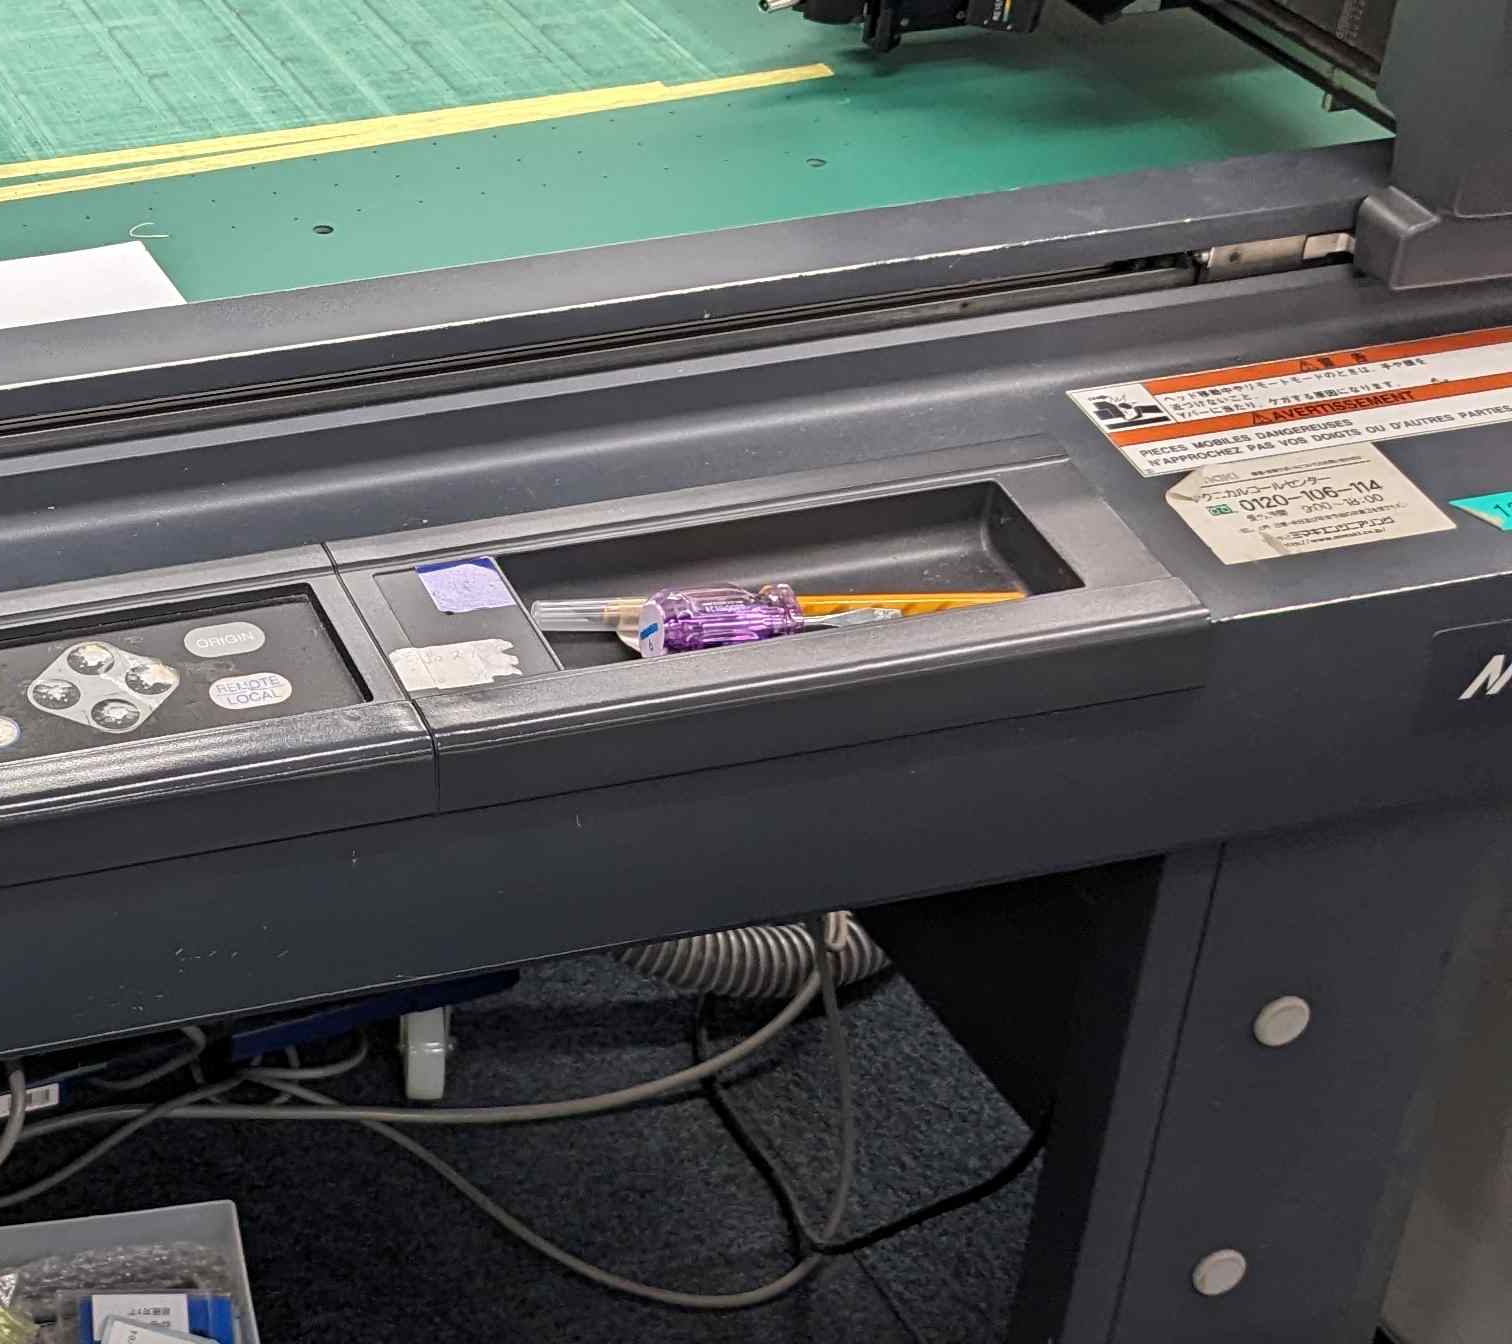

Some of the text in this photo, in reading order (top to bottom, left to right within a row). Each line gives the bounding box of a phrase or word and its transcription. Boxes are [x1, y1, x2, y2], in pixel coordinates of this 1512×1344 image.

[1271, 390, 1416, 422] AVERTISSEMENT
[1139, 419, 1354, 458] PIECES MOBILES DANGEREUSES
[1148, 445, 1241, 467] N'APPROCHEZ
[1248, 440, 1275, 452] PAS
[1279, 435, 1308, 447] VOS
[1311, 428, 1362, 443] DOIGTS
[1365, 423, 1386, 434] OU
[1389, 414, 1455, 431] D'AUTRES
[195, 631, 257, 649] ORIGIN
[215, 675, 280, 694] REMOTE
[226, 689, 283, 705] LOCAL
